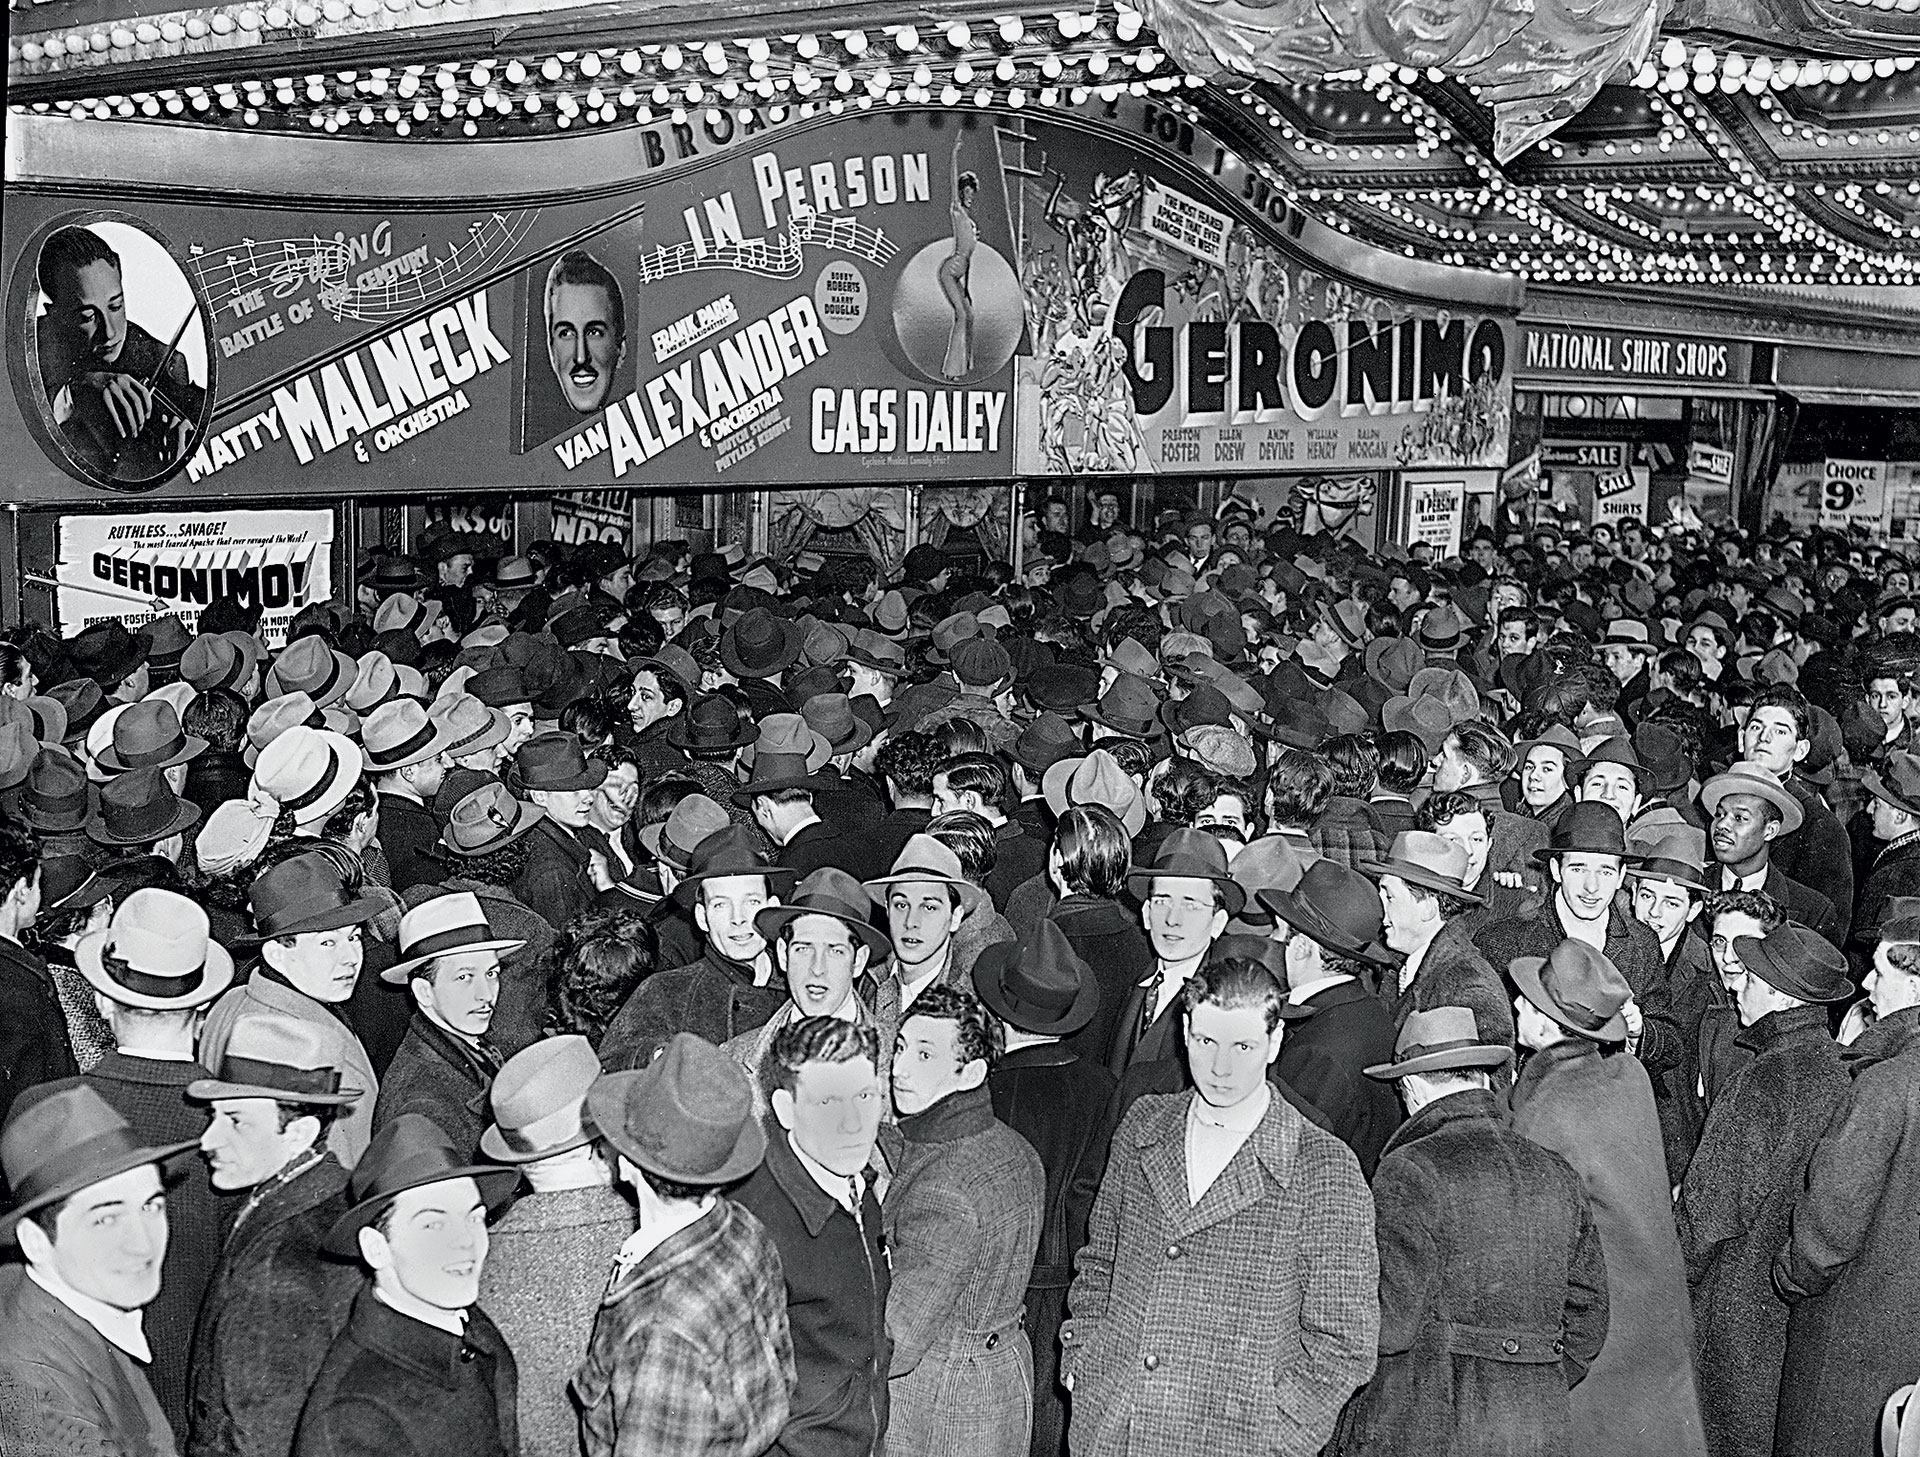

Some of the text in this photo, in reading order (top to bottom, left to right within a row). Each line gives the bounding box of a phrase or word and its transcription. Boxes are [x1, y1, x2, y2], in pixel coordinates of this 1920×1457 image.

[1144, 104, 1194, 155] FOR
[1243, 173, 1307, 239] SHOW
[683, 152, 930, 260] IN PERSON
[219, 312, 285, 358] BATTLE
[288, 298, 314, 325] OF
[356, 245, 429, 293] CENTURY
[228, 287, 265, 318] THE
[827, 280, 860, 293] ROBERTS
[651, 294, 735, 352] FRANK PARIS
[825, 304, 860, 316] DOUGLAS
[1110, 268, 1507, 418] GERONIMO
[1526, 331, 1728, 377] NATIONAL SHIRT SHOPS
[185, 289, 511, 483] MATTY MALNECK
[553, 295, 829, 479] VAN ALEXANDER
[354, 389, 471, 463] & ORCHESTRA
[699, 385, 784, 448] & ORCHESTRA
[811, 387, 1007, 453] CASS DALEY
[1161, 428, 1200, 442] PRESTON
[1218, 428, 1242, 442] ELLEN
[1267, 428, 1290, 441] ANDY
[715, 439, 757, 473] PHYLLIS
[1161, 440, 1388, 462] FOSTER DREW DEVINE HENRY MORGAN
[1578, 446, 1618, 465] SALE
[1826, 462, 1877, 480] CHOICE
[1599, 473, 1632, 495] SALE
[1602, 503, 1642, 514] SHIRTS
[133, 541, 145, 549] The
[147, 539, 164, 549] most
[165, 539, 189, 548] feared
[189, 538, 214, 550] Apache
[216, 537, 232, 546] that
[247, 534, 275, 548] ravaged
[275, 534, 286, 543] the
[287, 530, 308, 543] West!
[92, 550, 311, 609] GERONIMO!
[124, 613, 156, 625] FOSTER
